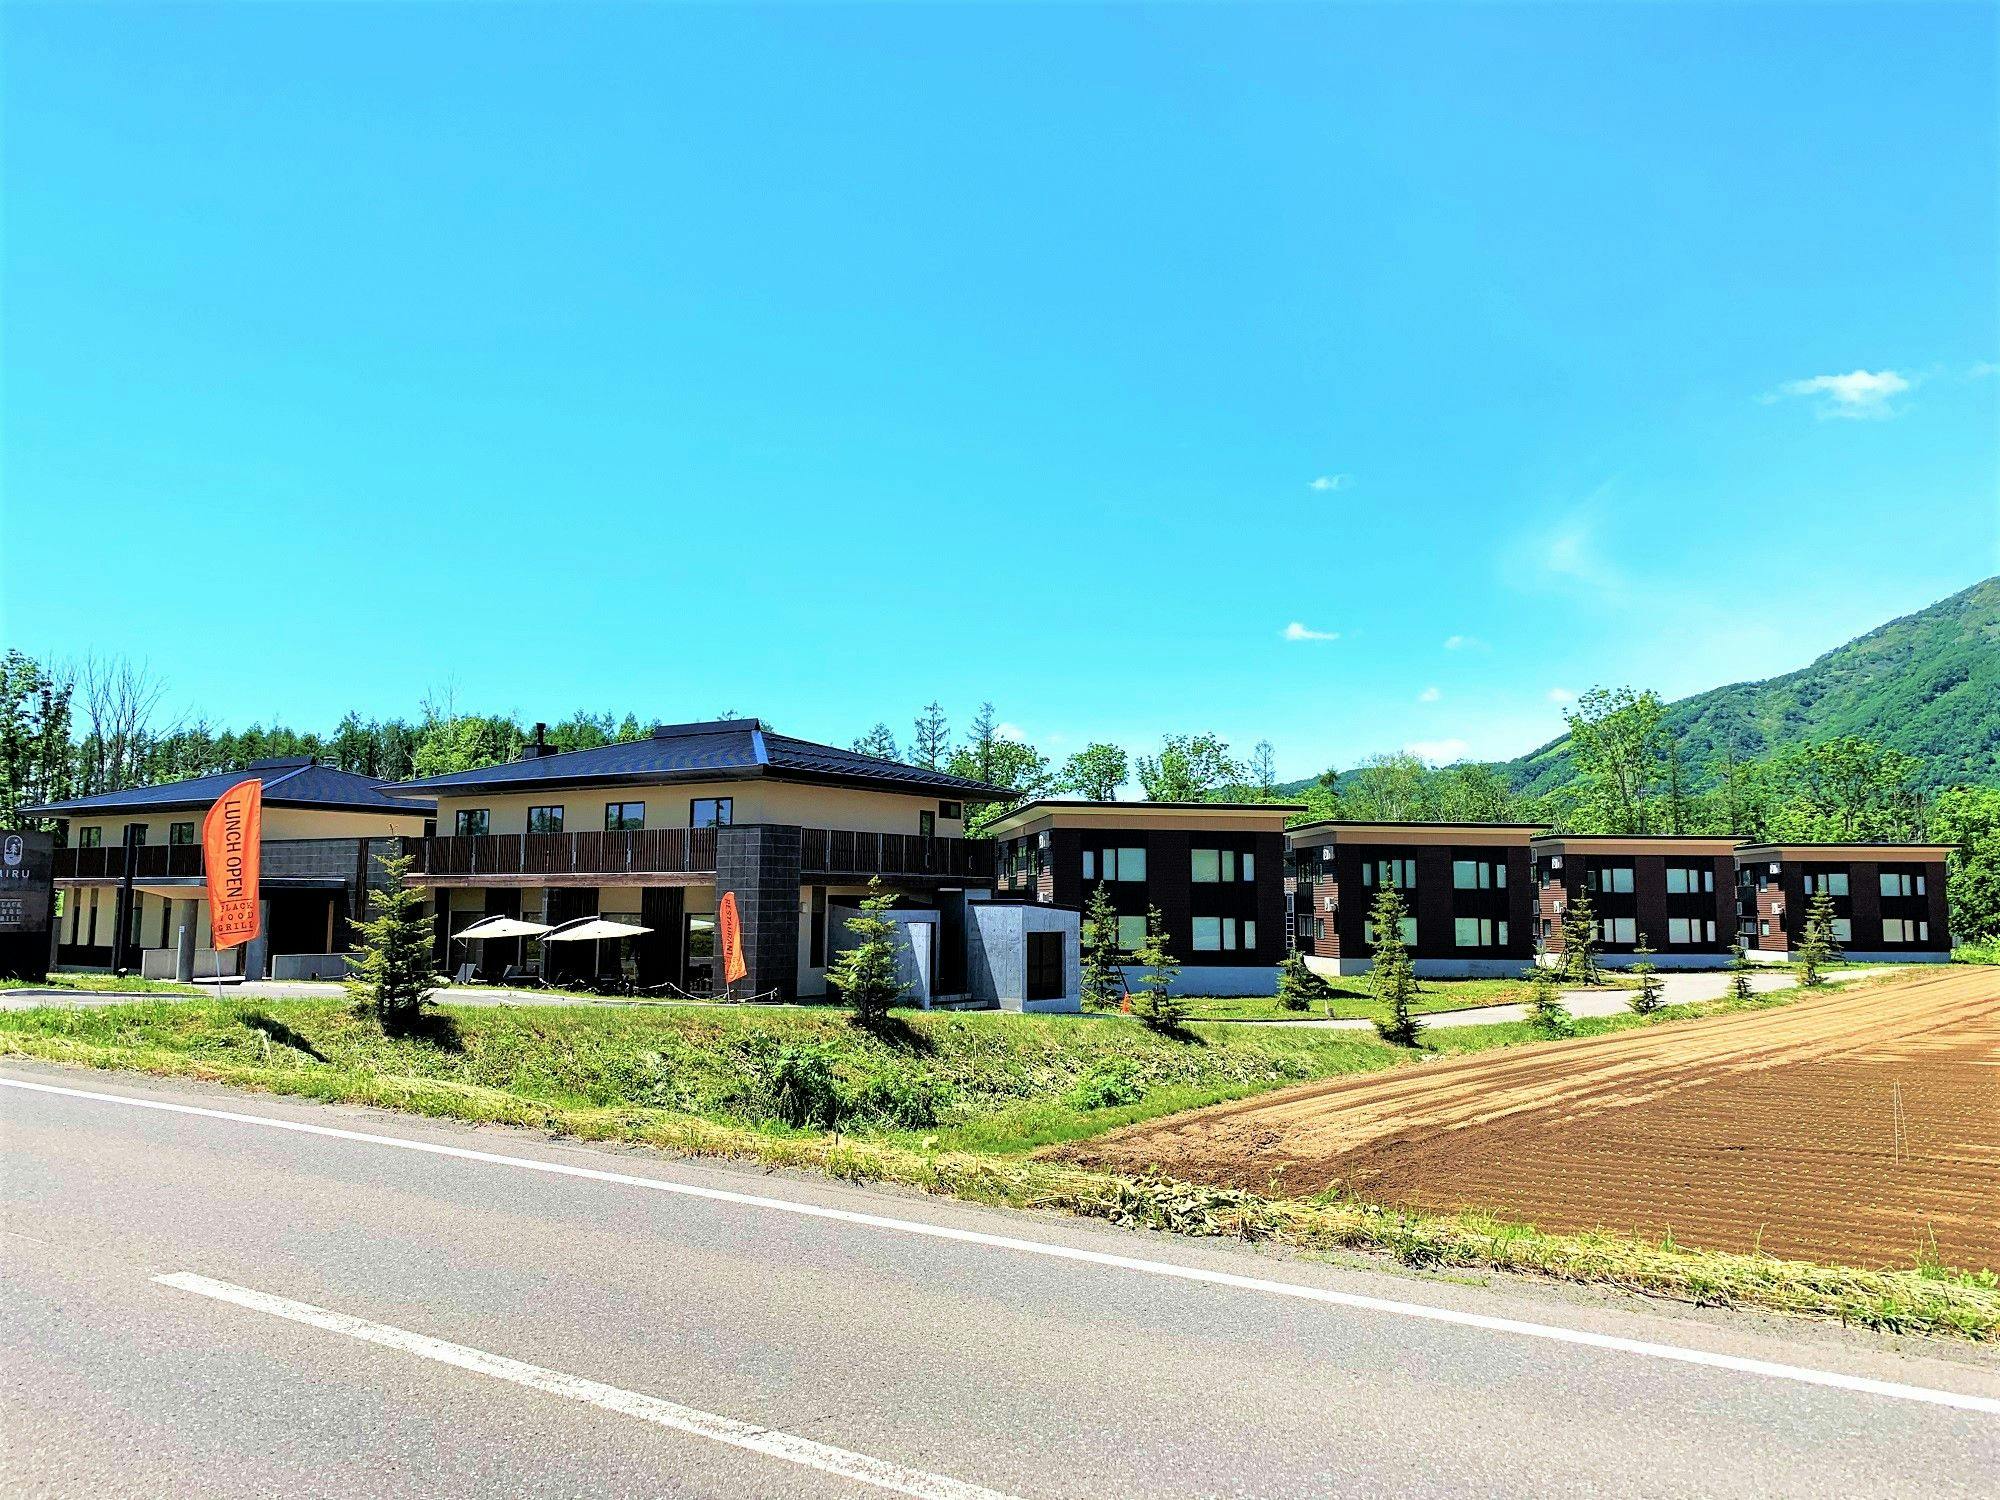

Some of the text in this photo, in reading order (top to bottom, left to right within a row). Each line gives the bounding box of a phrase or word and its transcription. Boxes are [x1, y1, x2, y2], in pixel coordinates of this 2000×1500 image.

[224, 800, 243, 898] LUNCH OPEN
[218, 921, 254, 932] GRILL
[725, 898, 733, 956] RESTAURANT
